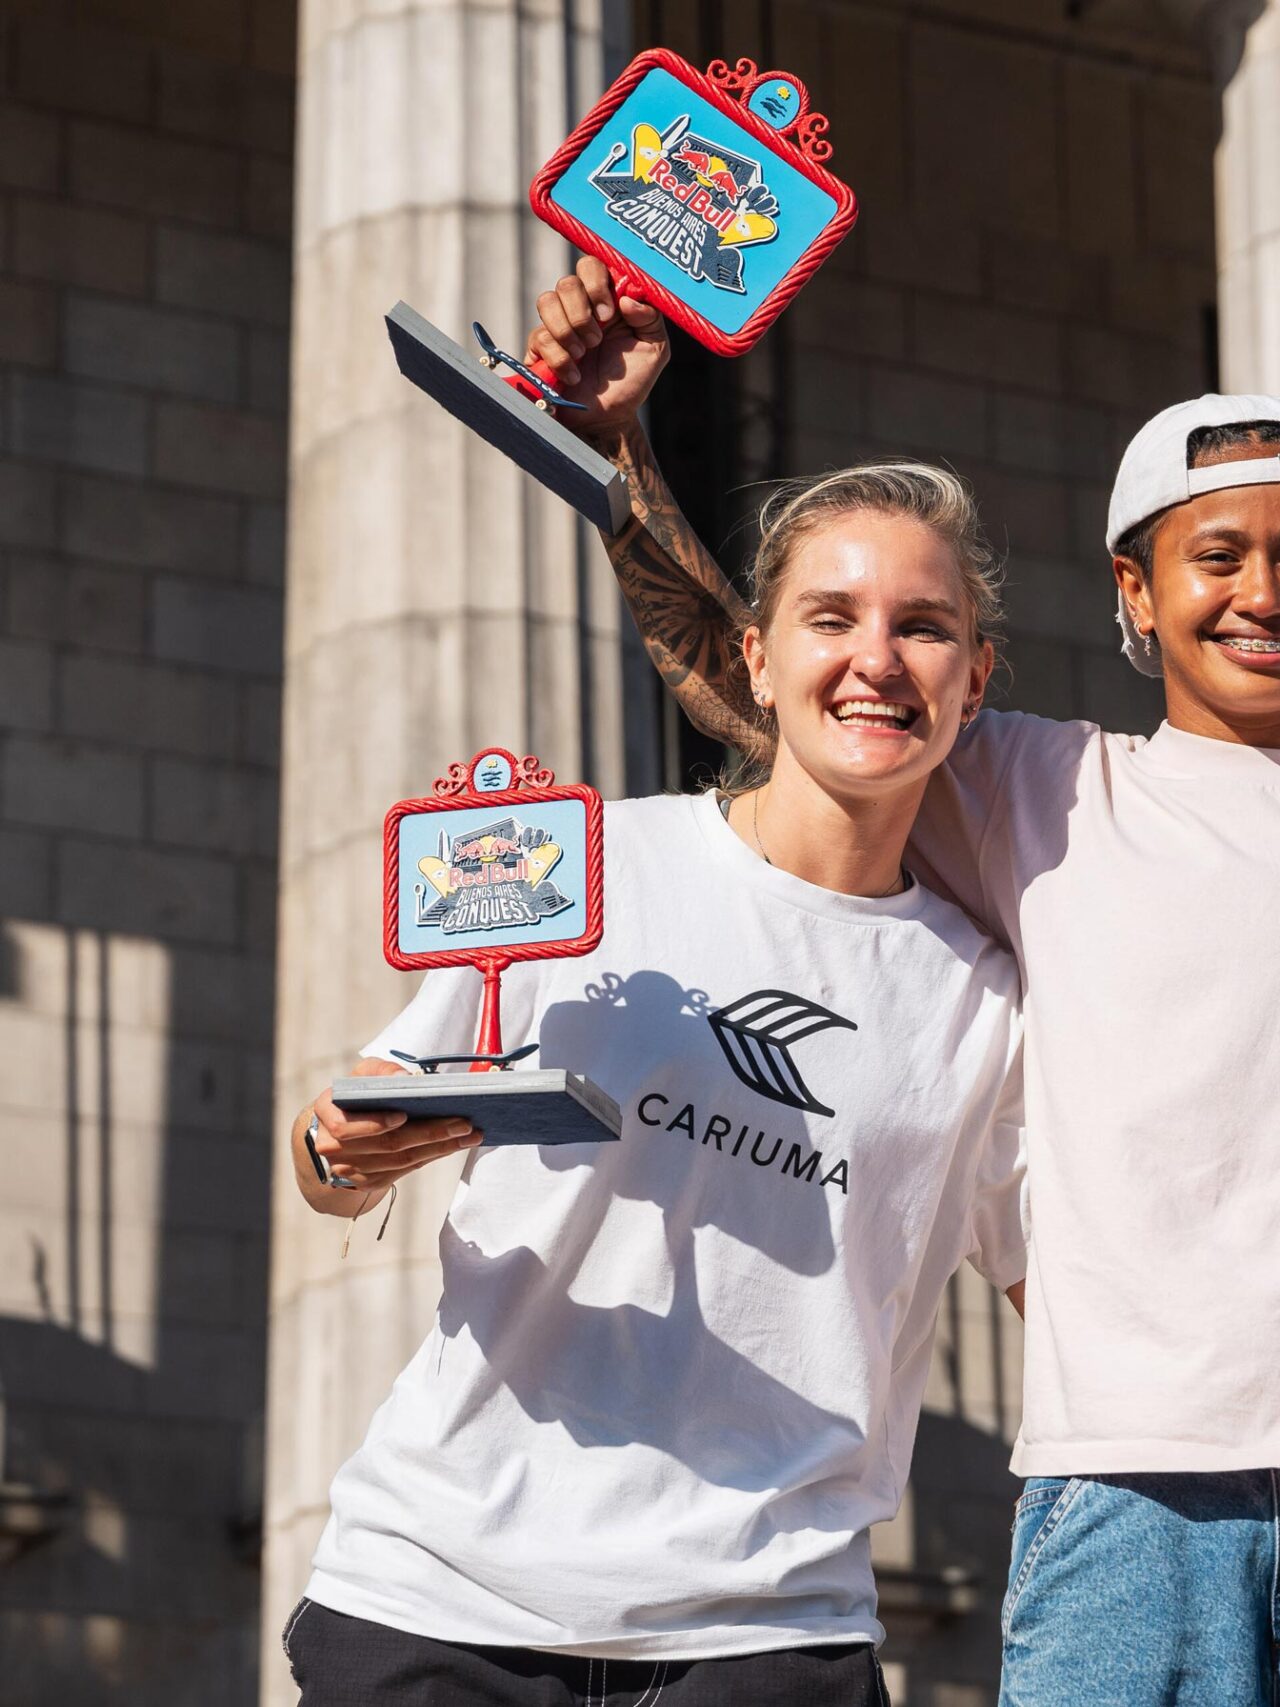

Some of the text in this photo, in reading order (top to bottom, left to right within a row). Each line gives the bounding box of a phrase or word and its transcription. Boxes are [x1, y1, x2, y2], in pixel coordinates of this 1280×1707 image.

[636, 188, 708, 247] BUENOS AIRES
[648, 157, 737, 232] Red Bull
[610, 200, 703, 273] CONQUEST
[449, 859, 529, 888] Red Bull
[456, 883, 522, 907] BUENOS AIRES
[445, 898, 533, 928] CONQUEST
[637, 1093, 849, 1194] CARIUMA
